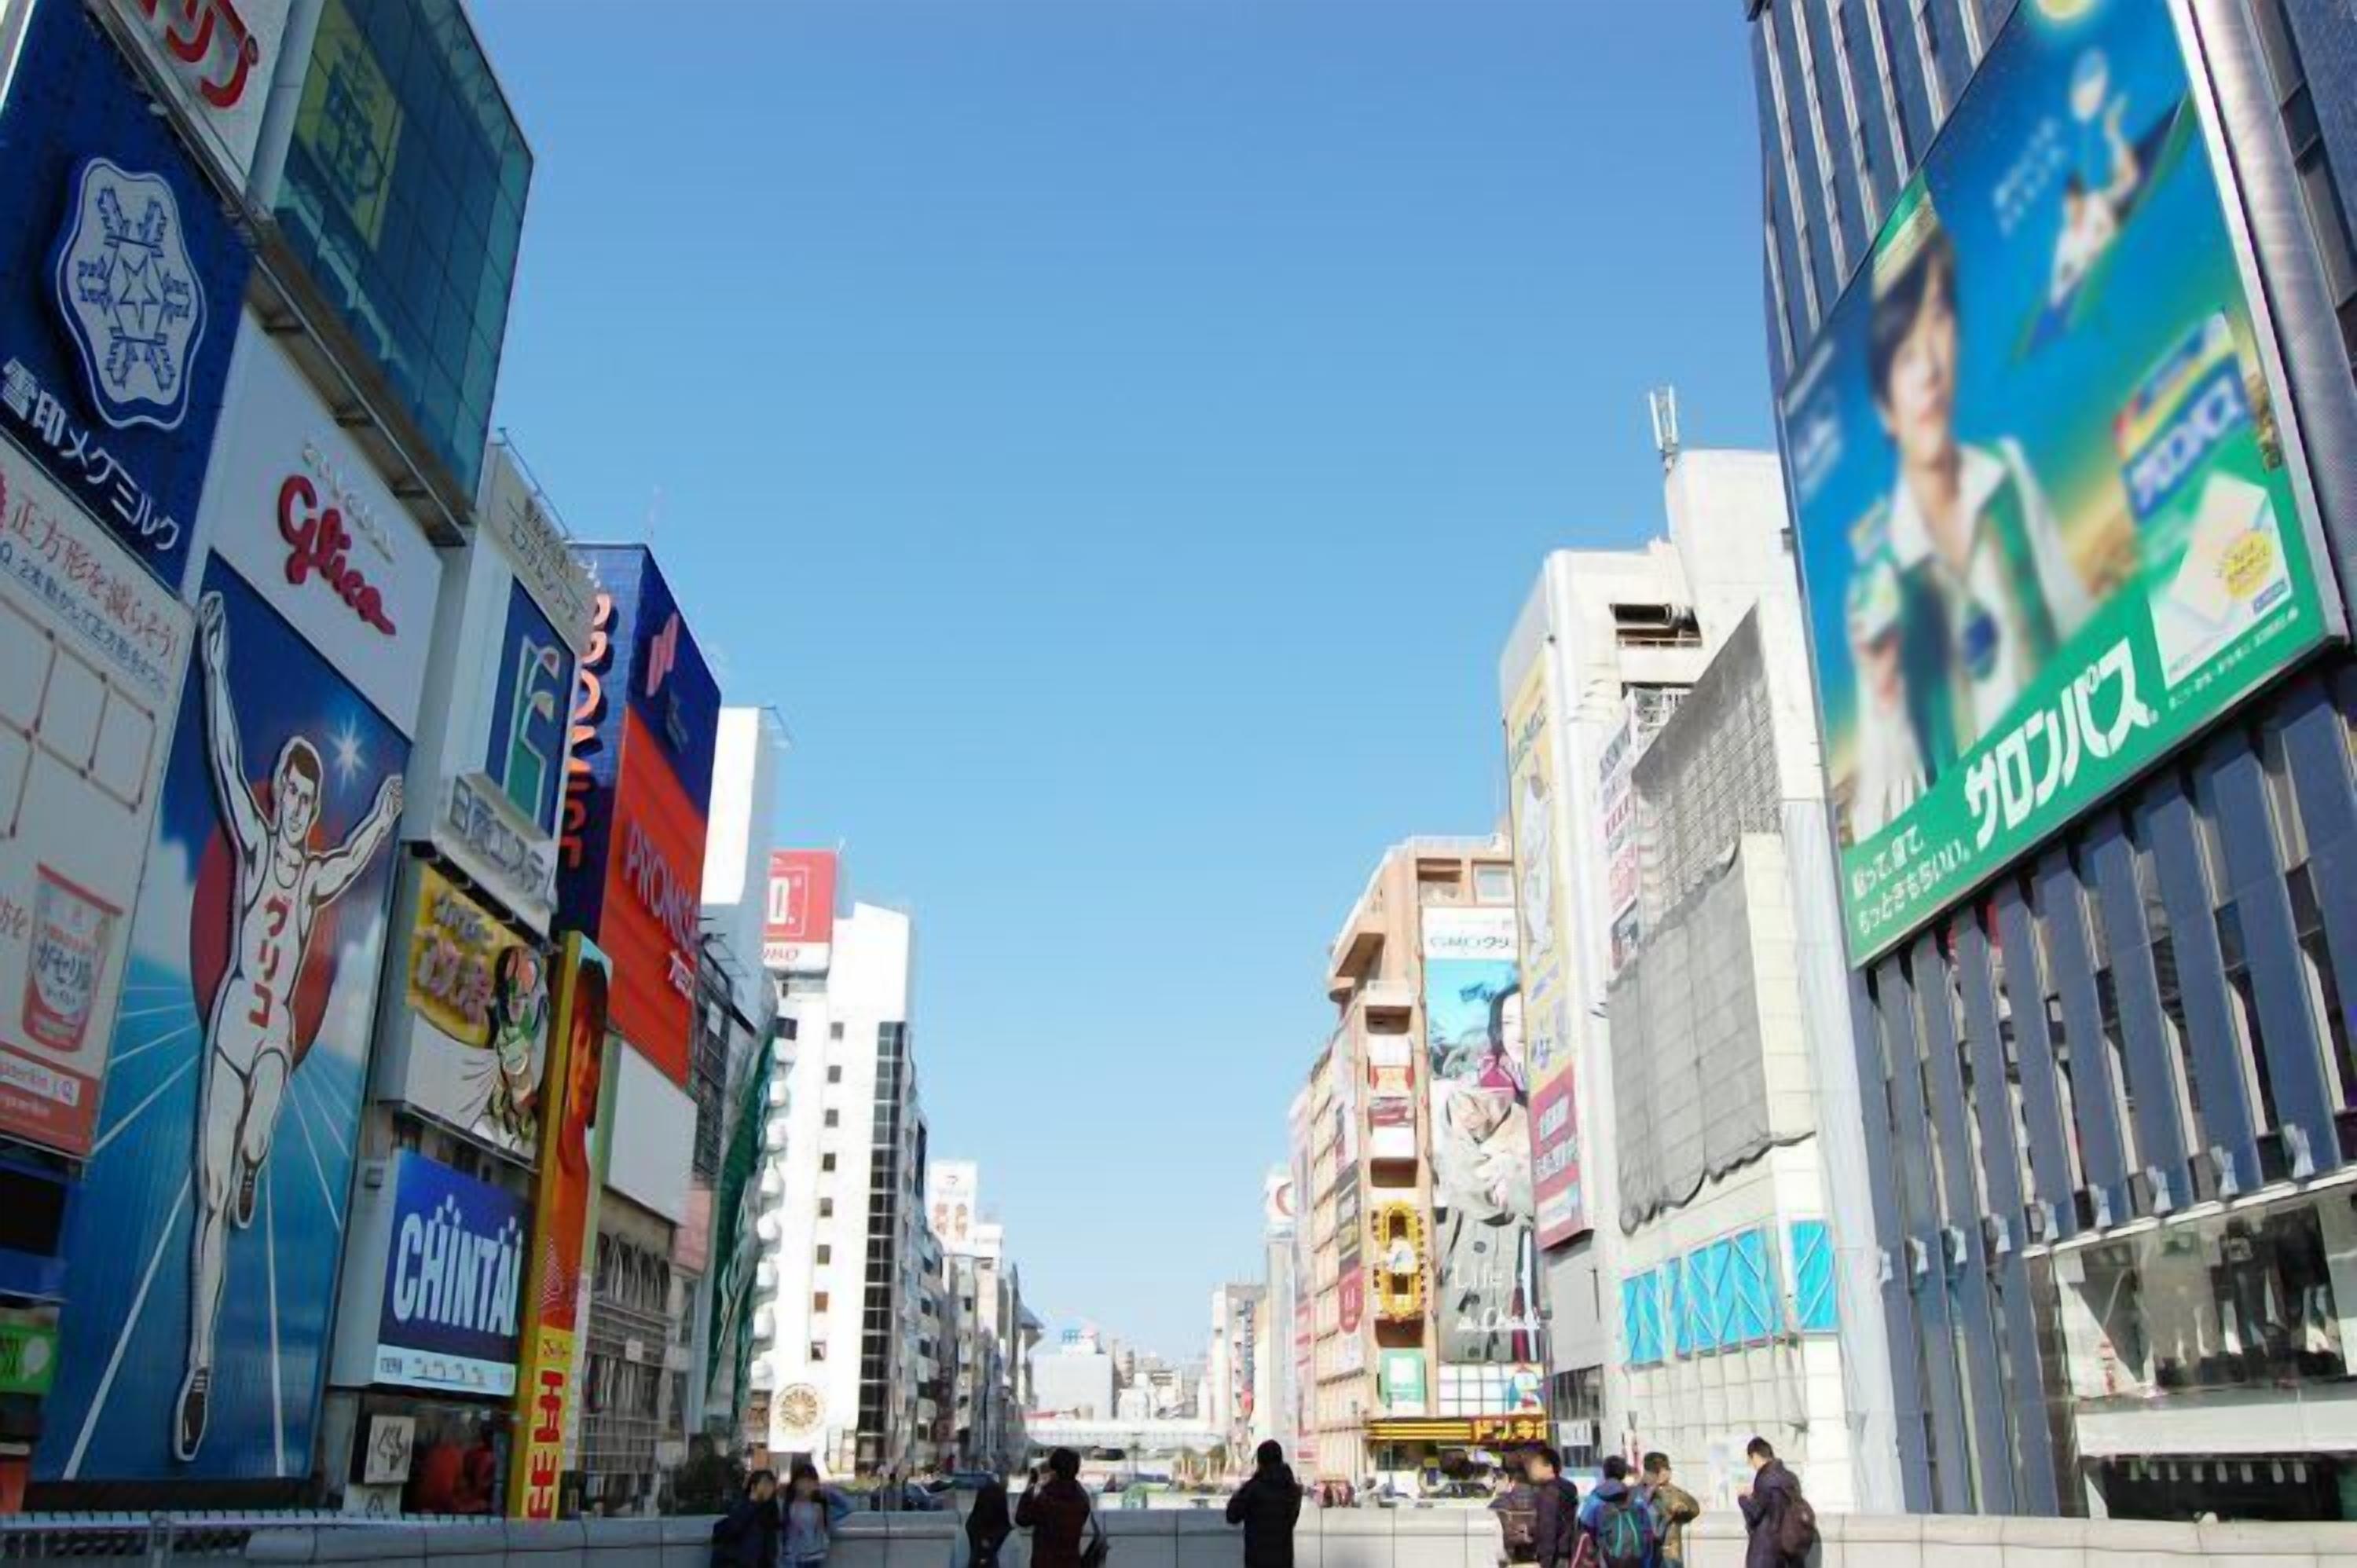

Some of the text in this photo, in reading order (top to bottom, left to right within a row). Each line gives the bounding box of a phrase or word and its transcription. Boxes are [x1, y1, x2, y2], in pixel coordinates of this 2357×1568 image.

[2, 357, 180, 550] 雪印メグミルク
[277, 474, 396, 636] Glico
[1964, 636, 2151, 852] サロンパス
[248, 893, 292, 1029] グリコ
[393, 1194, 524, 1337] CHINTAI
